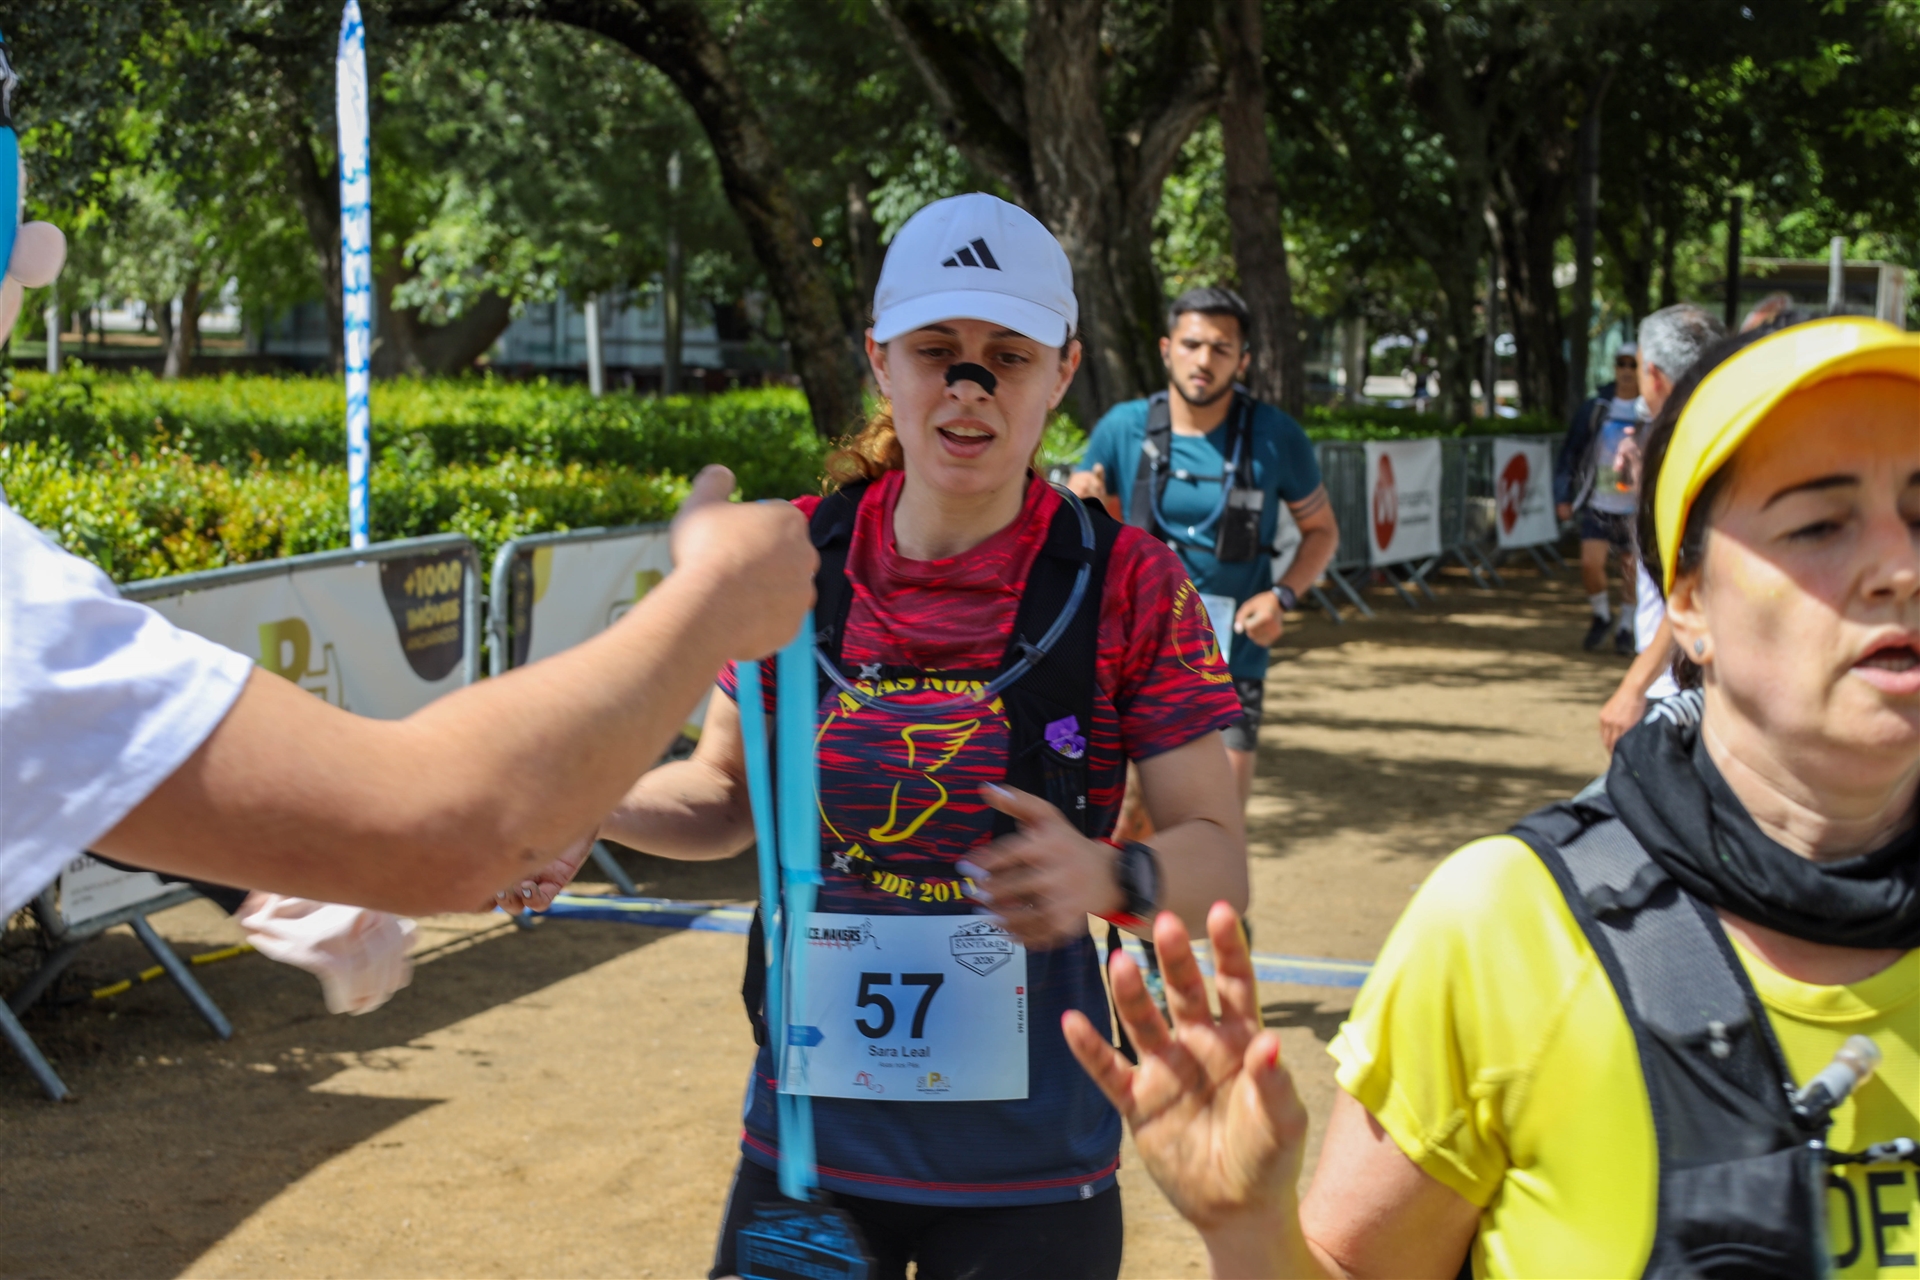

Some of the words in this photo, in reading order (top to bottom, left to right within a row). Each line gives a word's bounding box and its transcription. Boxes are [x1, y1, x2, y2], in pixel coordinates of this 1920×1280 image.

[404, 560, 462, 598] +1000
[855, 972, 944, 1038] 57
[868, 1045, 898, 1057] Sara
[902, 1046, 931, 1057] Leal
[1827, 1171, 1920, 1268] DE
